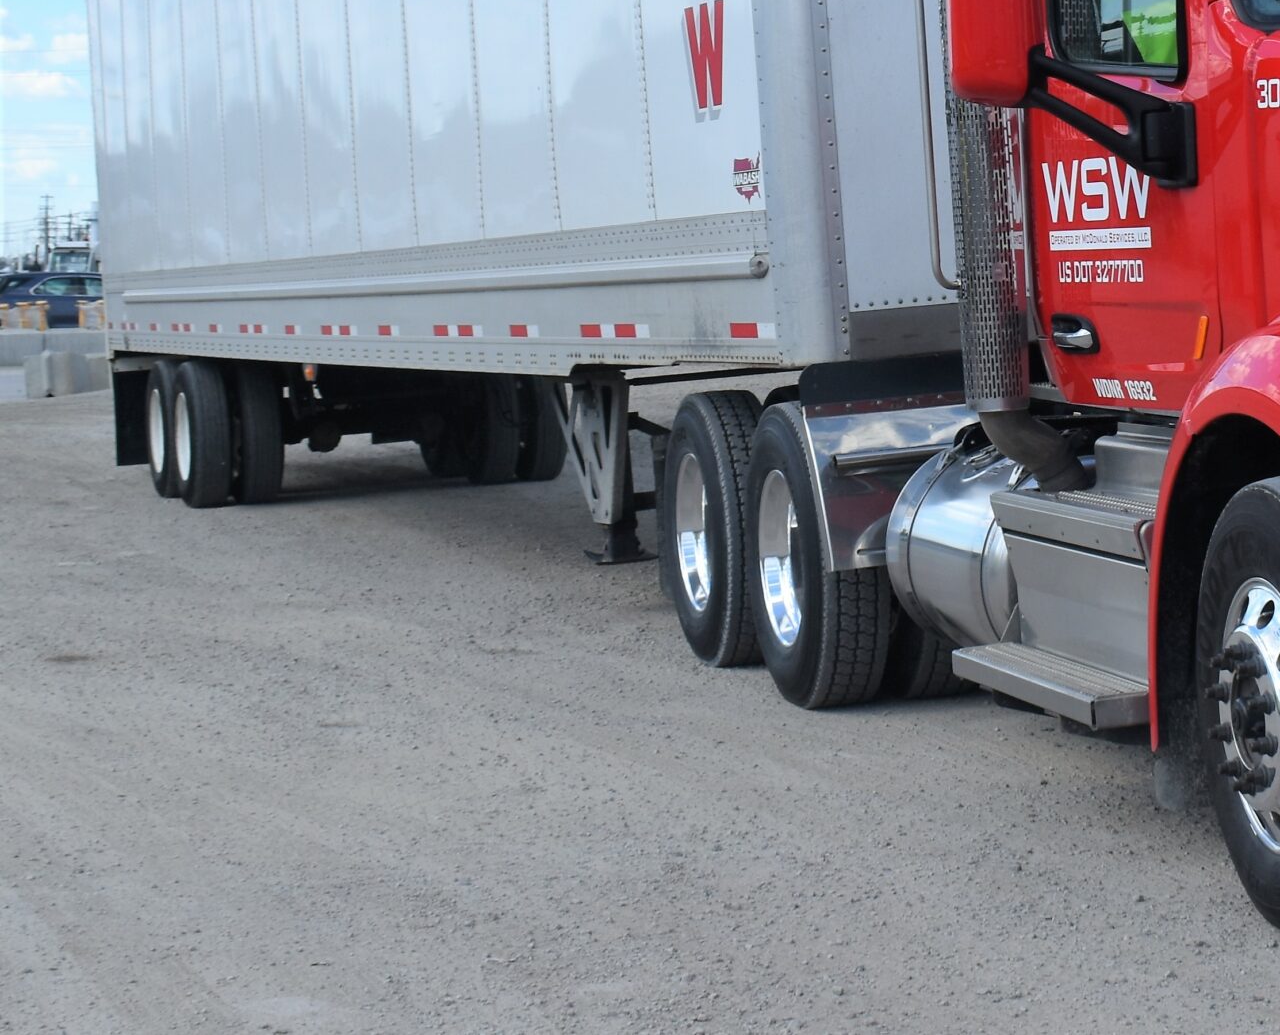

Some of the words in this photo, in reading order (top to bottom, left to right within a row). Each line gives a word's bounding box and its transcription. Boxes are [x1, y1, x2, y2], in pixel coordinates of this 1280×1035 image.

[732, 170, 760, 186] WABASH
[1041, 156, 1150, 223] WSW
[1058, 261, 1072, 282] US
[1074, 260, 1093, 282] DOT
[1095, 259, 1144, 282] 3277700
[1092, 378, 1125, 399] WDNR
[1124, 380, 1157, 401] 16932
